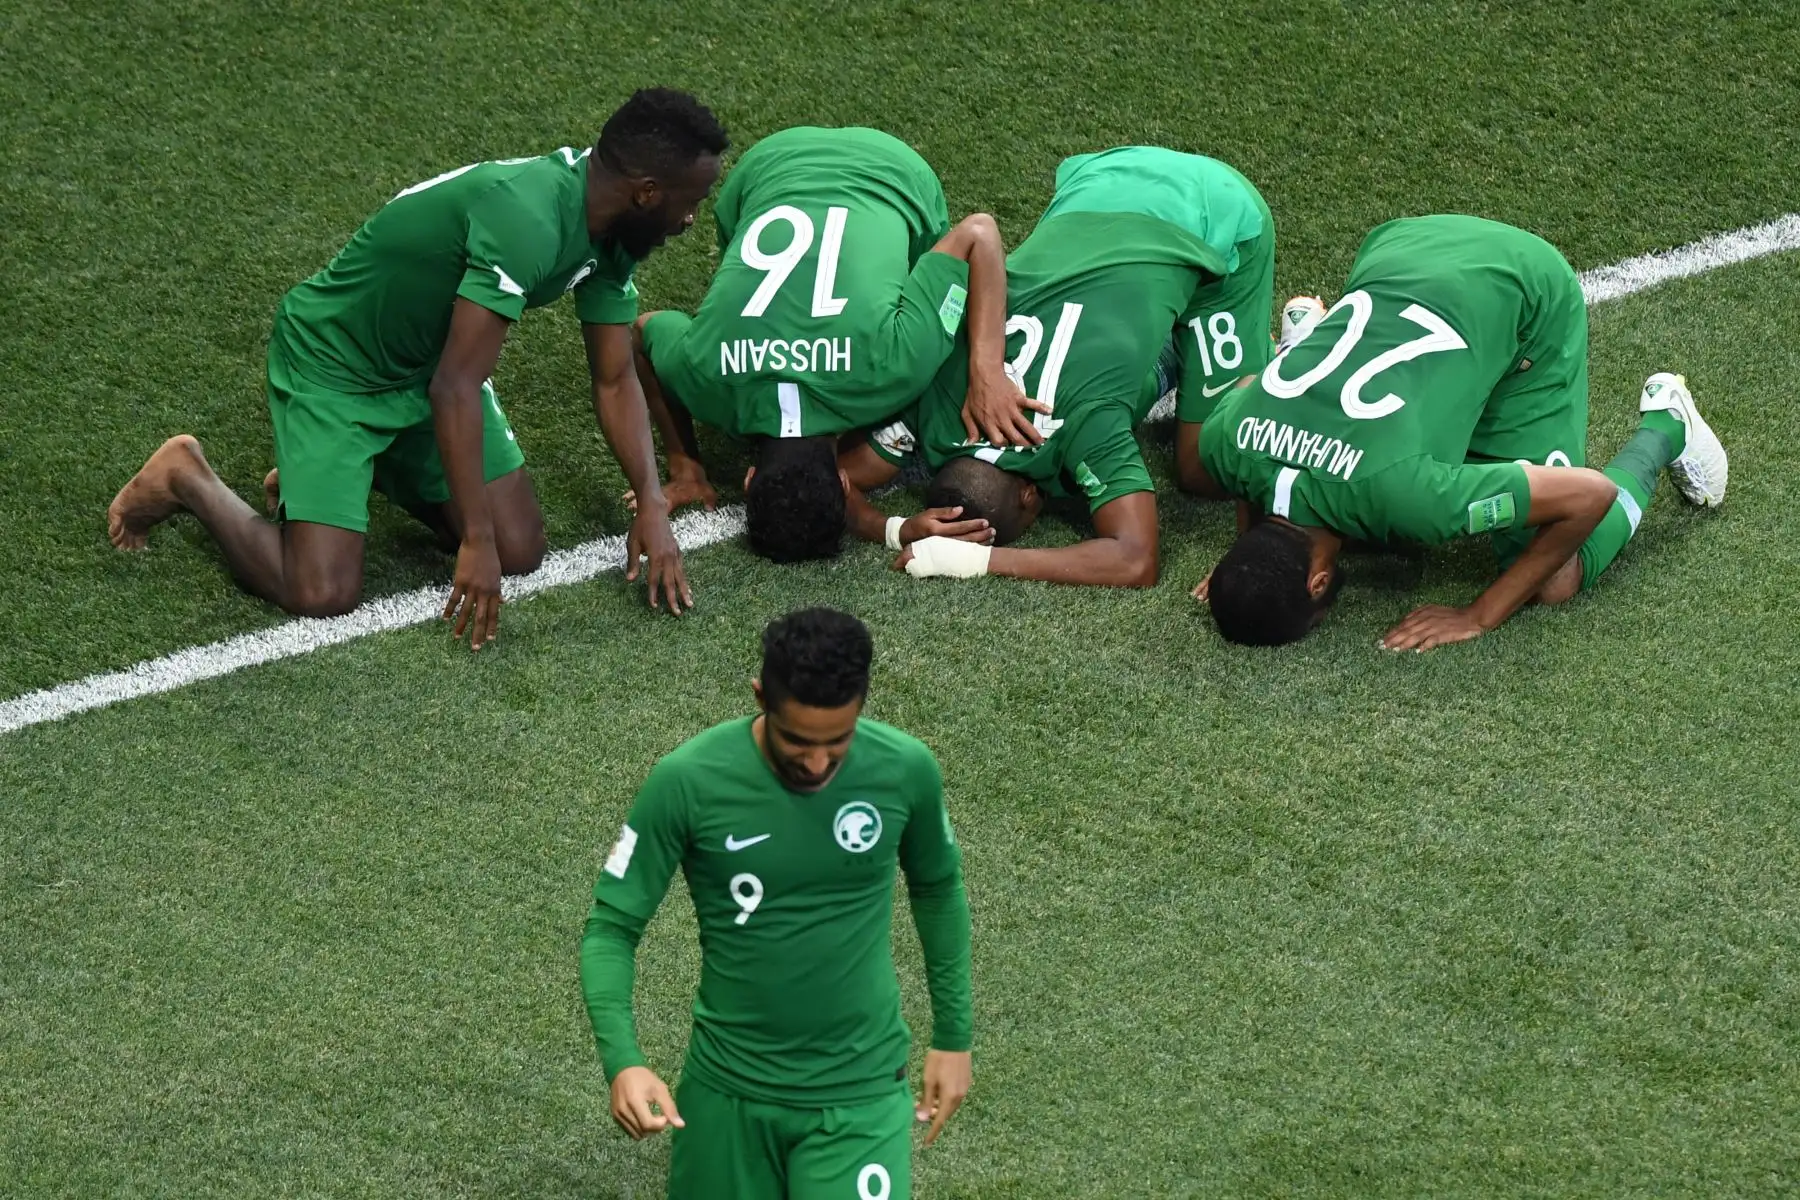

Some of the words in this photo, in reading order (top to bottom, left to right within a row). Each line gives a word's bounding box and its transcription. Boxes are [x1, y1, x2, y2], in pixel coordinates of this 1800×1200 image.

[741, 204, 849, 318] 16
[720, 336, 851, 376] HUSSAIN
[1188, 311, 1243, 377] 18
[1261, 289, 1469, 420] 20
[1236, 416, 1364, 481] MUHANNAD
[729, 872, 764, 925] 9
